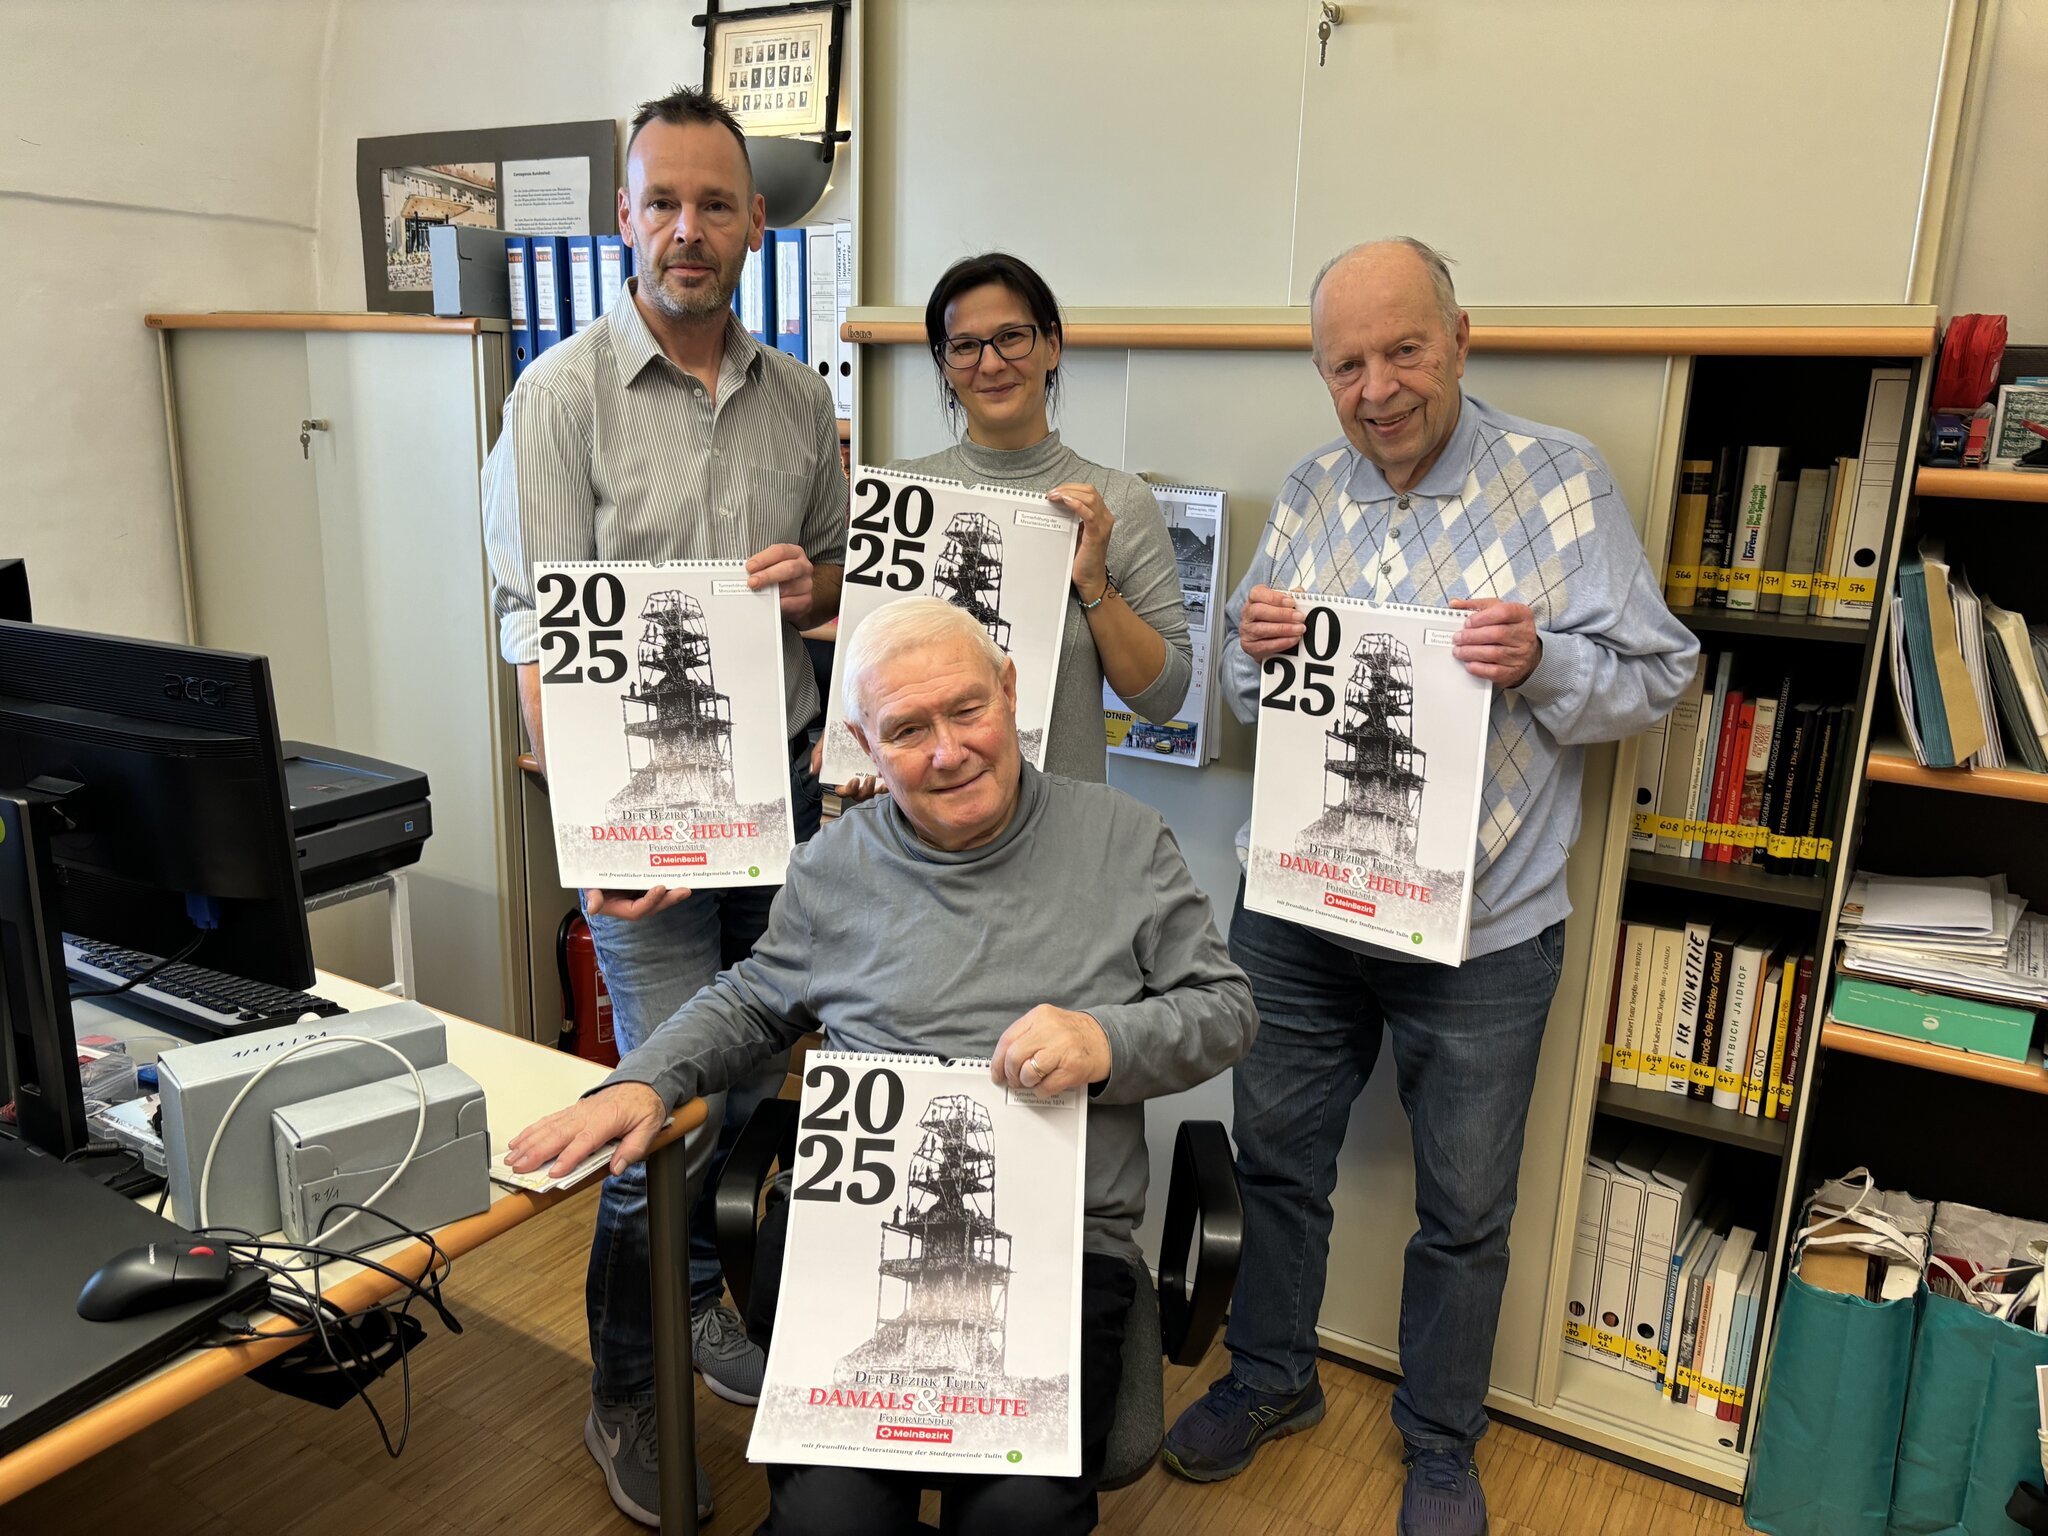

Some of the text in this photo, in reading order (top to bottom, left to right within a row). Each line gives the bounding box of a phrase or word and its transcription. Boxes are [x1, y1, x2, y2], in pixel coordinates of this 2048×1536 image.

[848, 325, 872, 338] bene
[852, 478, 934, 538] 20
[1744, 529, 1758, 558] Lorenz
[845, 533, 925, 591] 25
[1675, 570, 1691, 579] 566
[1703, 571, 1717, 581] 567
[1719, 574, 1730, 583] 68
[1733, 572, 1750, 582] 569
[1791, 579, 1808, 589] 572
[1848, 583, 1865, 593] 576
[537, 573, 626, 627] 20
[541, 630, 628, 684] 25
[162, 673, 237, 706] acer
[1262, 657, 1335, 716] 25
[1779, 727, 1802, 834] TERNEUBURG Die Stadt
[622, 810, 645, 820] DER
[650, 809, 687, 820] BEZIRK
[1636, 814, 1647, 823] 07
[591, 819, 759, 843] DAMALS & HEUTE
[1660, 821, 1679, 832] 608
[1684, 825, 1696, 833] 09
[1722, 830, 1736, 839] 12
[663, 856, 705, 864] MeinBezirk
[1309, 843, 1329, 857] DER
[1333, 849, 1368, 865] BEZIRK
[1279, 853, 1433, 904] DAMALS & HEUTE
[1335, 899, 1374, 914] MeinBezirk
[1682, 931, 1705, 1016] INDUSTRIE
[1705, 951, 1723, 1037] des Bezirkes Gmünd
[1725, 965, 1747, 1072] MATBUCH JAIDHOF
[1791, 1026, 1801, 1058] Biographie
[1616, 1050, 1632, 1058] 644
[1755, 1049, 1767, 1067] NÖ
[1650, 1063, 1656, 1071] 2
[1670, 1063, 1686, 1071] 645
[1694, 1068, 1709, 1079] 646
[1718, 1076, 1734, 1086] 647
[801, 1065, 905, 1135] 20
[793, 1134, 896, 1205] 25
[1598, 1333, 1613, 1344] 681
[1635, 1344, 1652, 1356] 681
[855, 1371, 988, 1390] DER BEZIRK TULLN
[1679, 1370, 1691, 1378] 84
[1701, 1382, 1720, 1393] 686
[808, 1387, 1029, 1417] DAMALS & HEUTE
[893, 1429, 950, 1440] MeinBezirk
[816, 1443, 861, 1452] freundlicher
[862, 1446, 913, 1456] Unterstützung
[929, 1450, 983, 1459] Stadtgemeinde
